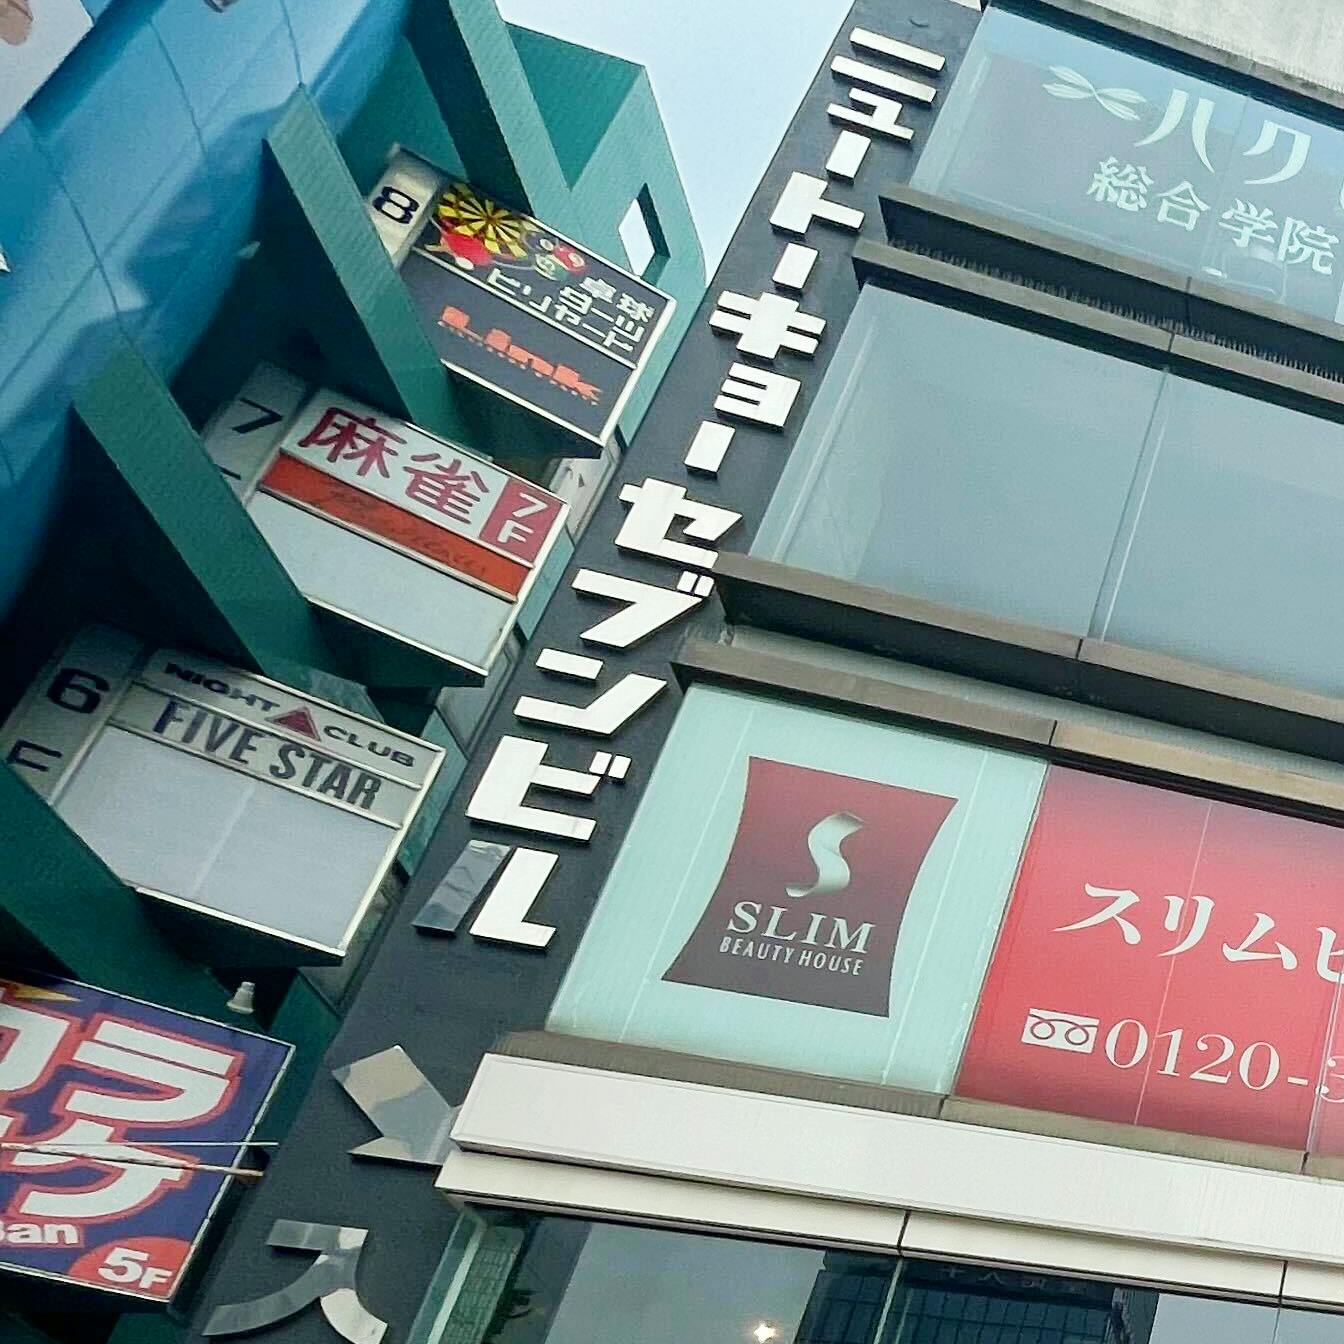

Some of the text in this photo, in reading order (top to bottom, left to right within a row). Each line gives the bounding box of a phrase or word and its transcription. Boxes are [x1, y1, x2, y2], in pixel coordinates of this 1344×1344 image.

[1086, 156, 1341, 276] 総合学院
[299, 406, 489, 527] 麻雀
[152, 693, 383, 811] FIVE STAR
[163, 662, 417, 768] NIGHT CLUB
[718, 934, 864, 977] BEAUTY HOUSE
[726, 900, 876, 955] SLIM
[97, 1246, 173, 1289] 5F
